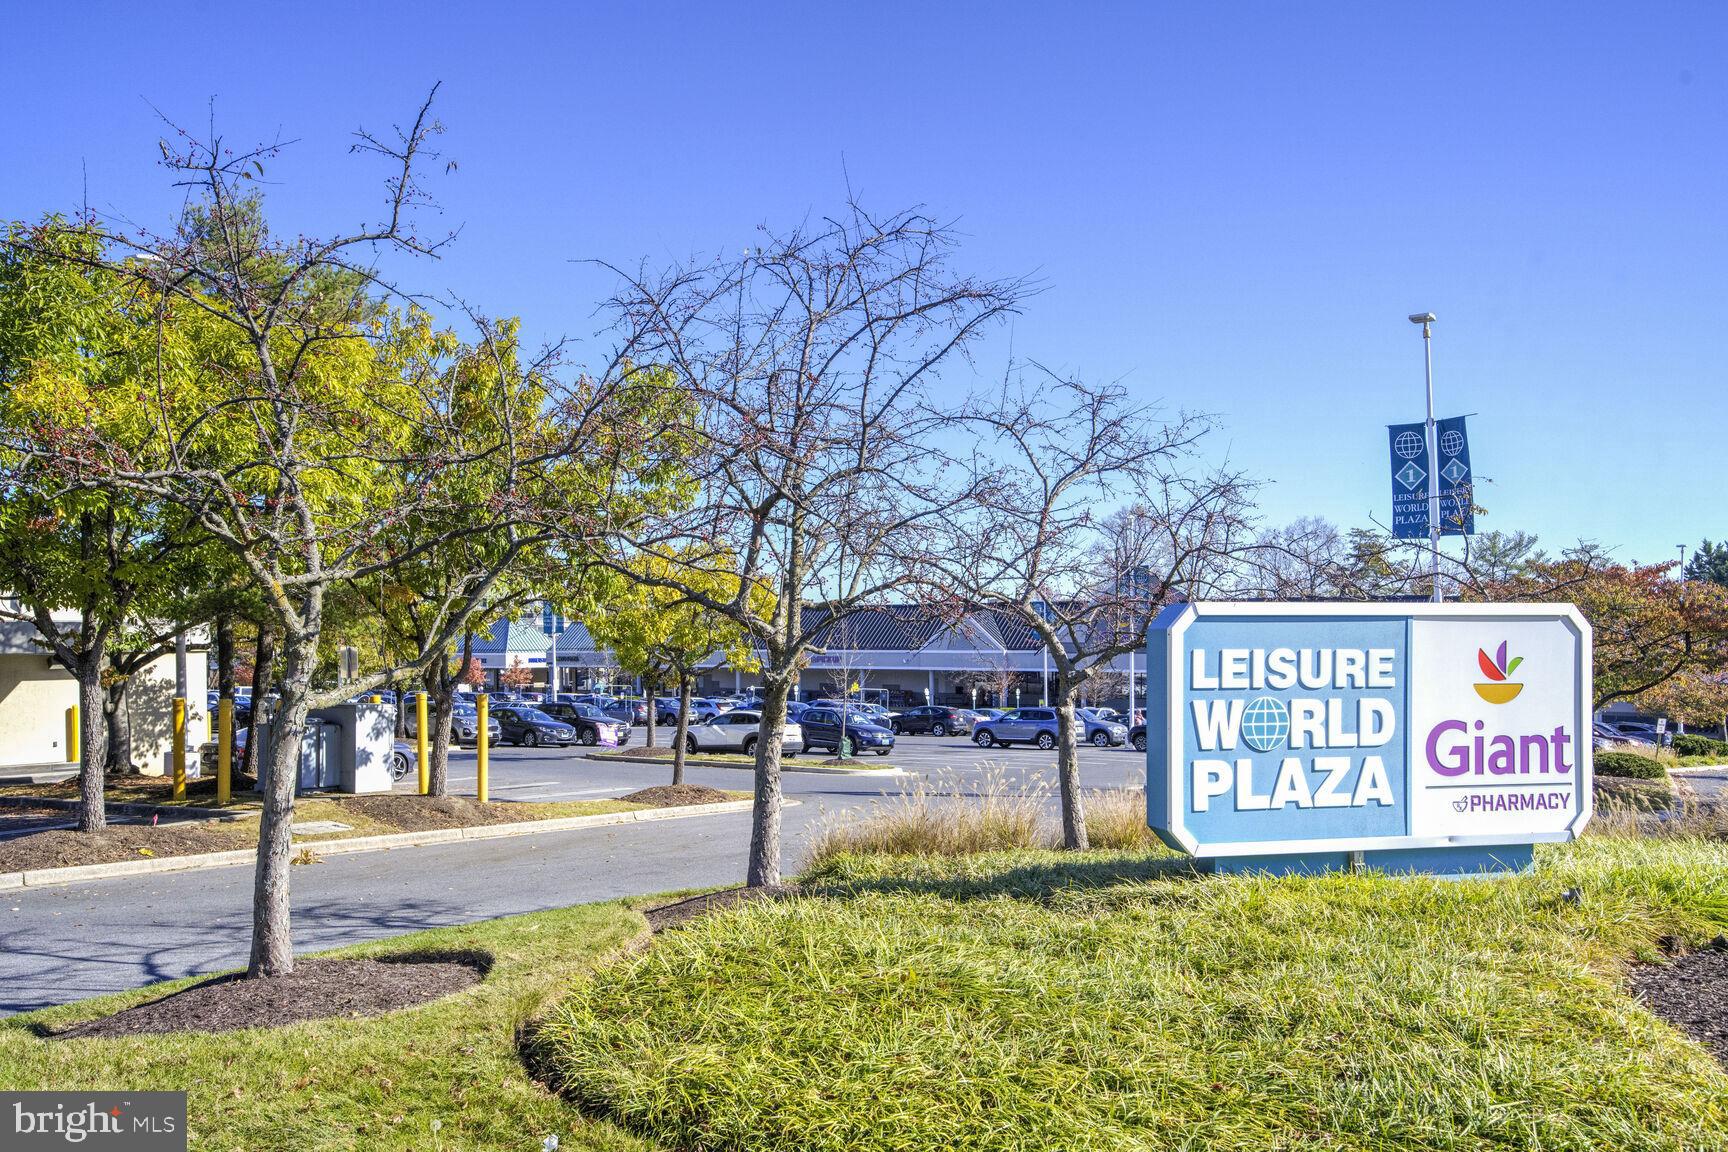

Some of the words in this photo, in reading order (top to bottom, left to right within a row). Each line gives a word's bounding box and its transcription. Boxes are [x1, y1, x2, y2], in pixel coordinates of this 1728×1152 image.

[1406, 469, 1415, 483] 1
[1450, 466, 1459, 479] 1
[1393, 503, 1429, 513] WORLD
[1395, 514, 1429, 524] PLAZA
[1190, 647, 1396, 690] LEISURE
[1425, 719, 1573, 777] Giant
[1191, 755, 1395, 813] PLAZA
[1470, 792, 1570, 812] PHARMACY
